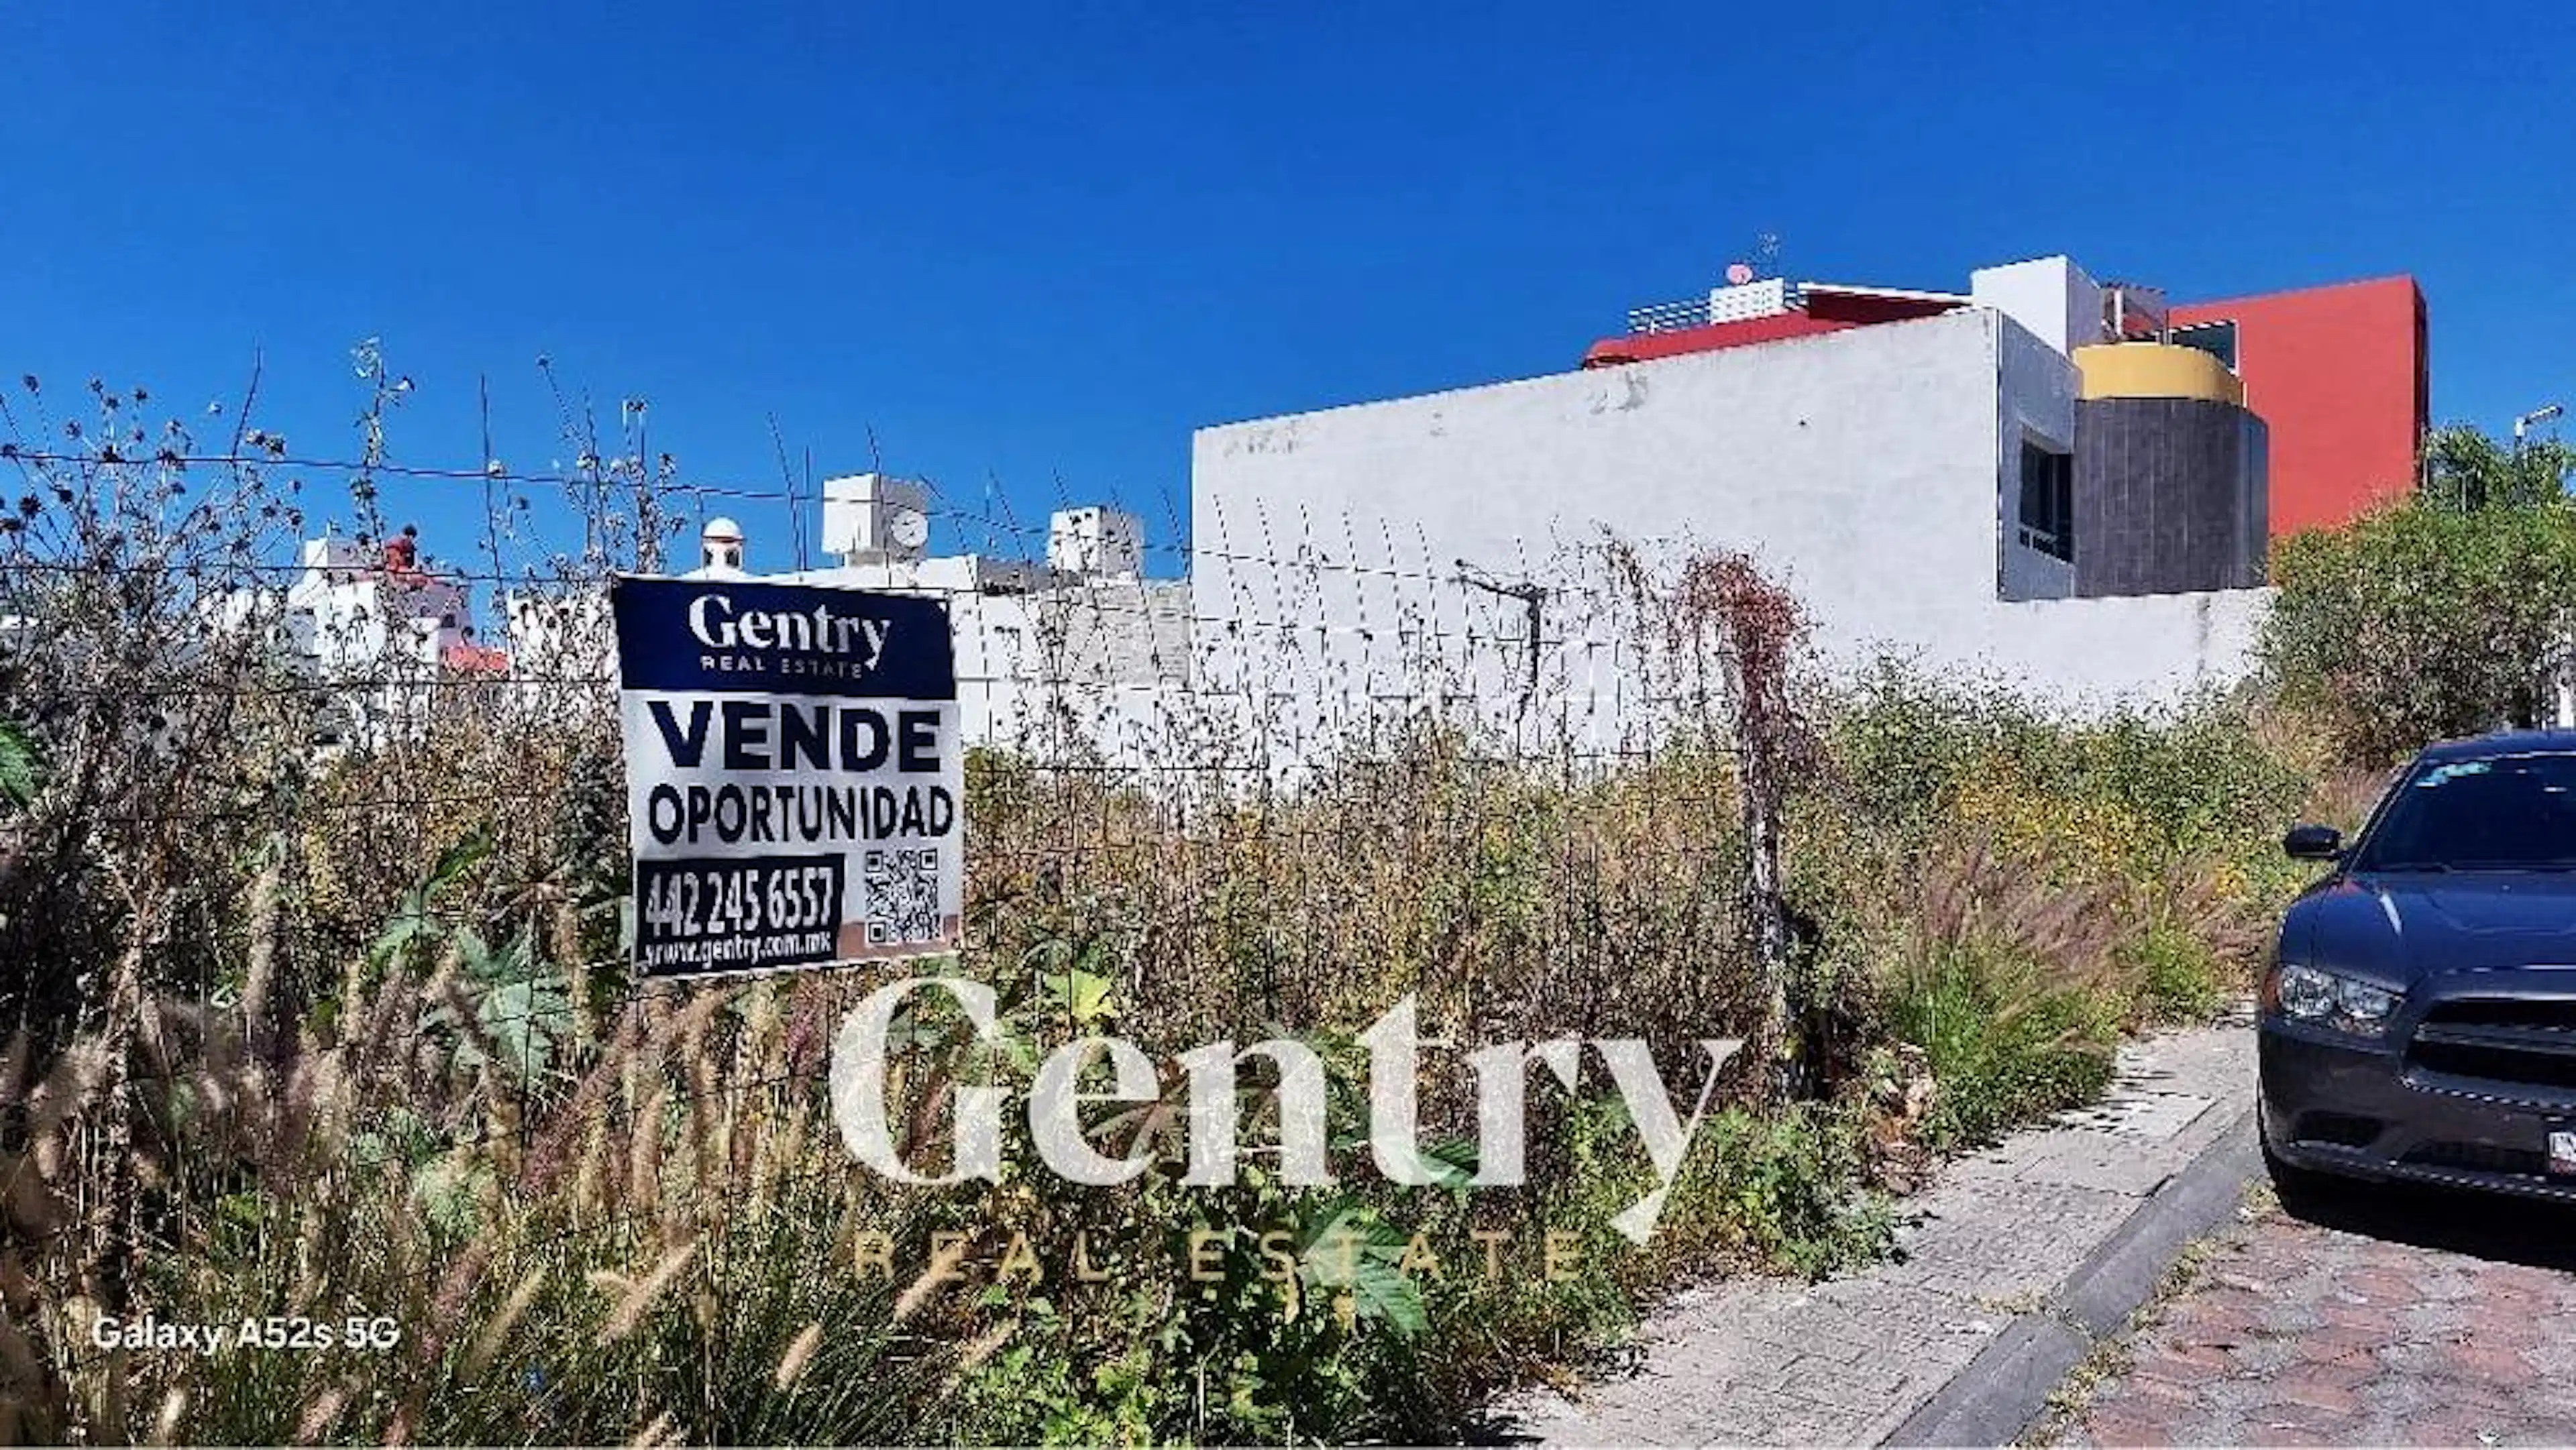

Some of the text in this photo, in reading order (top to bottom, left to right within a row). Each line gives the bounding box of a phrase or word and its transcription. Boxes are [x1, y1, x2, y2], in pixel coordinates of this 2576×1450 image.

[688, 594, 890, 671] Gentry
[700, 655, 863, 679] REAL ESTATE
[646, 700, 941, 773] VENDE
[648, 783, 954, 845] OPORTUNIDAD
[645, 867, 834, 936] 442 245 6557
